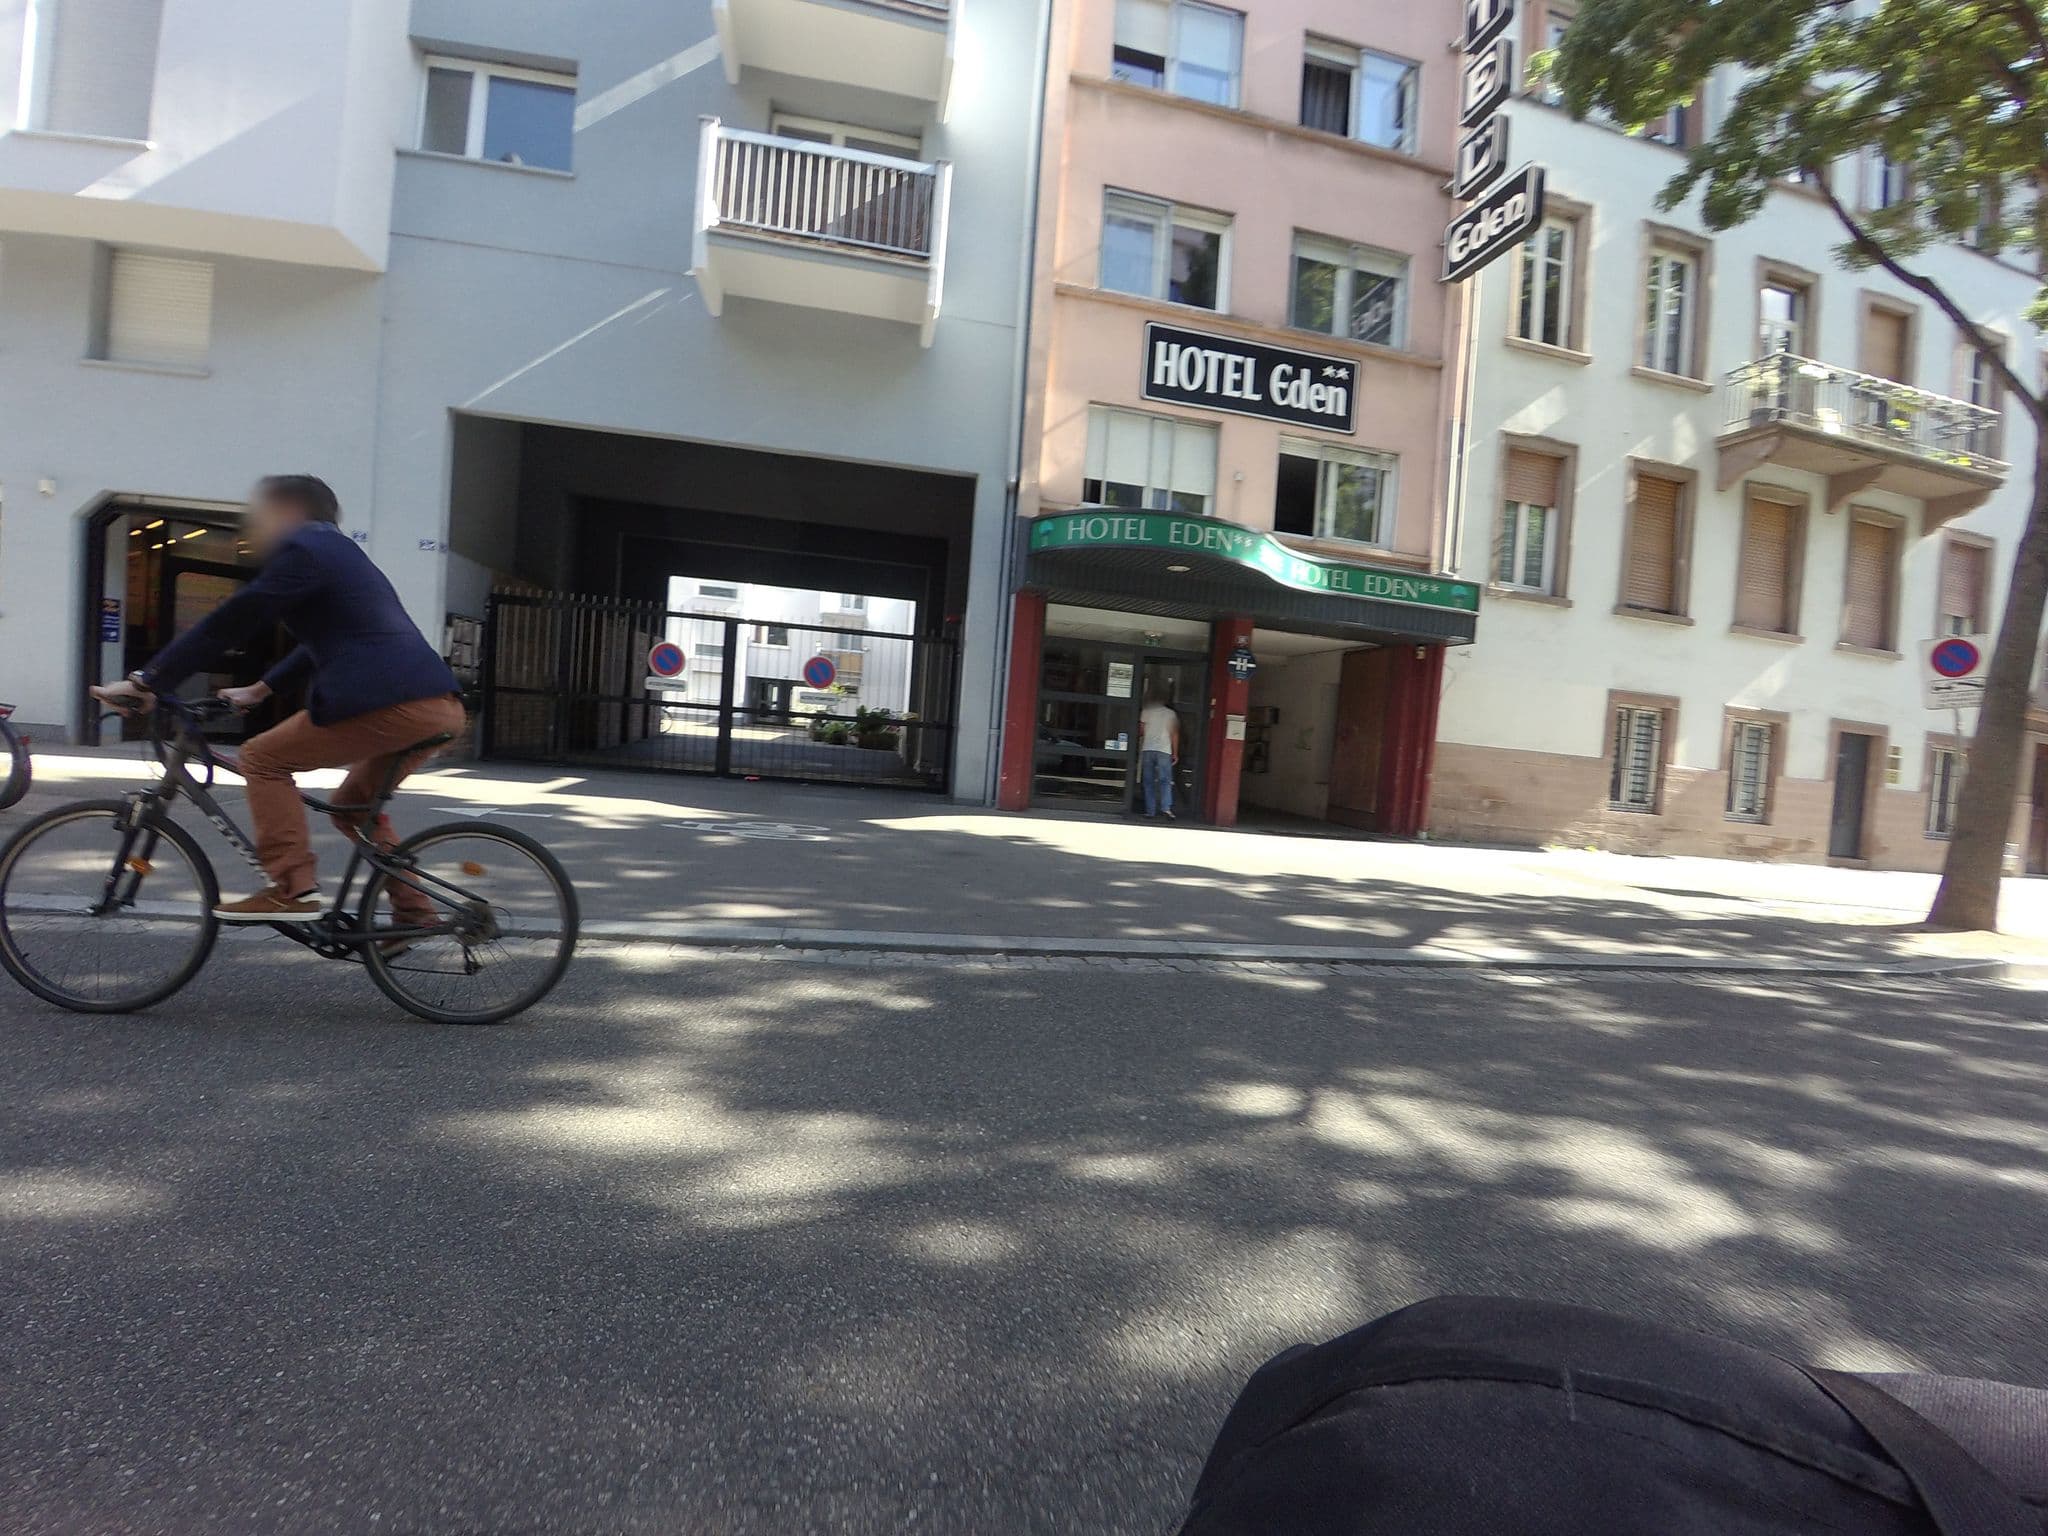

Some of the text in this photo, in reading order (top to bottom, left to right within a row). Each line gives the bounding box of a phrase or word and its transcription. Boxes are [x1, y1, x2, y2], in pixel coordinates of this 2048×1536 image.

[1450, 193, 1525, 262] Eden
[1152, 340, 1348, 416] HOTEL Eden
[1067, 517, 1152, 541] HOTEL
[1291, 561, 1352, 590] HOTEL
